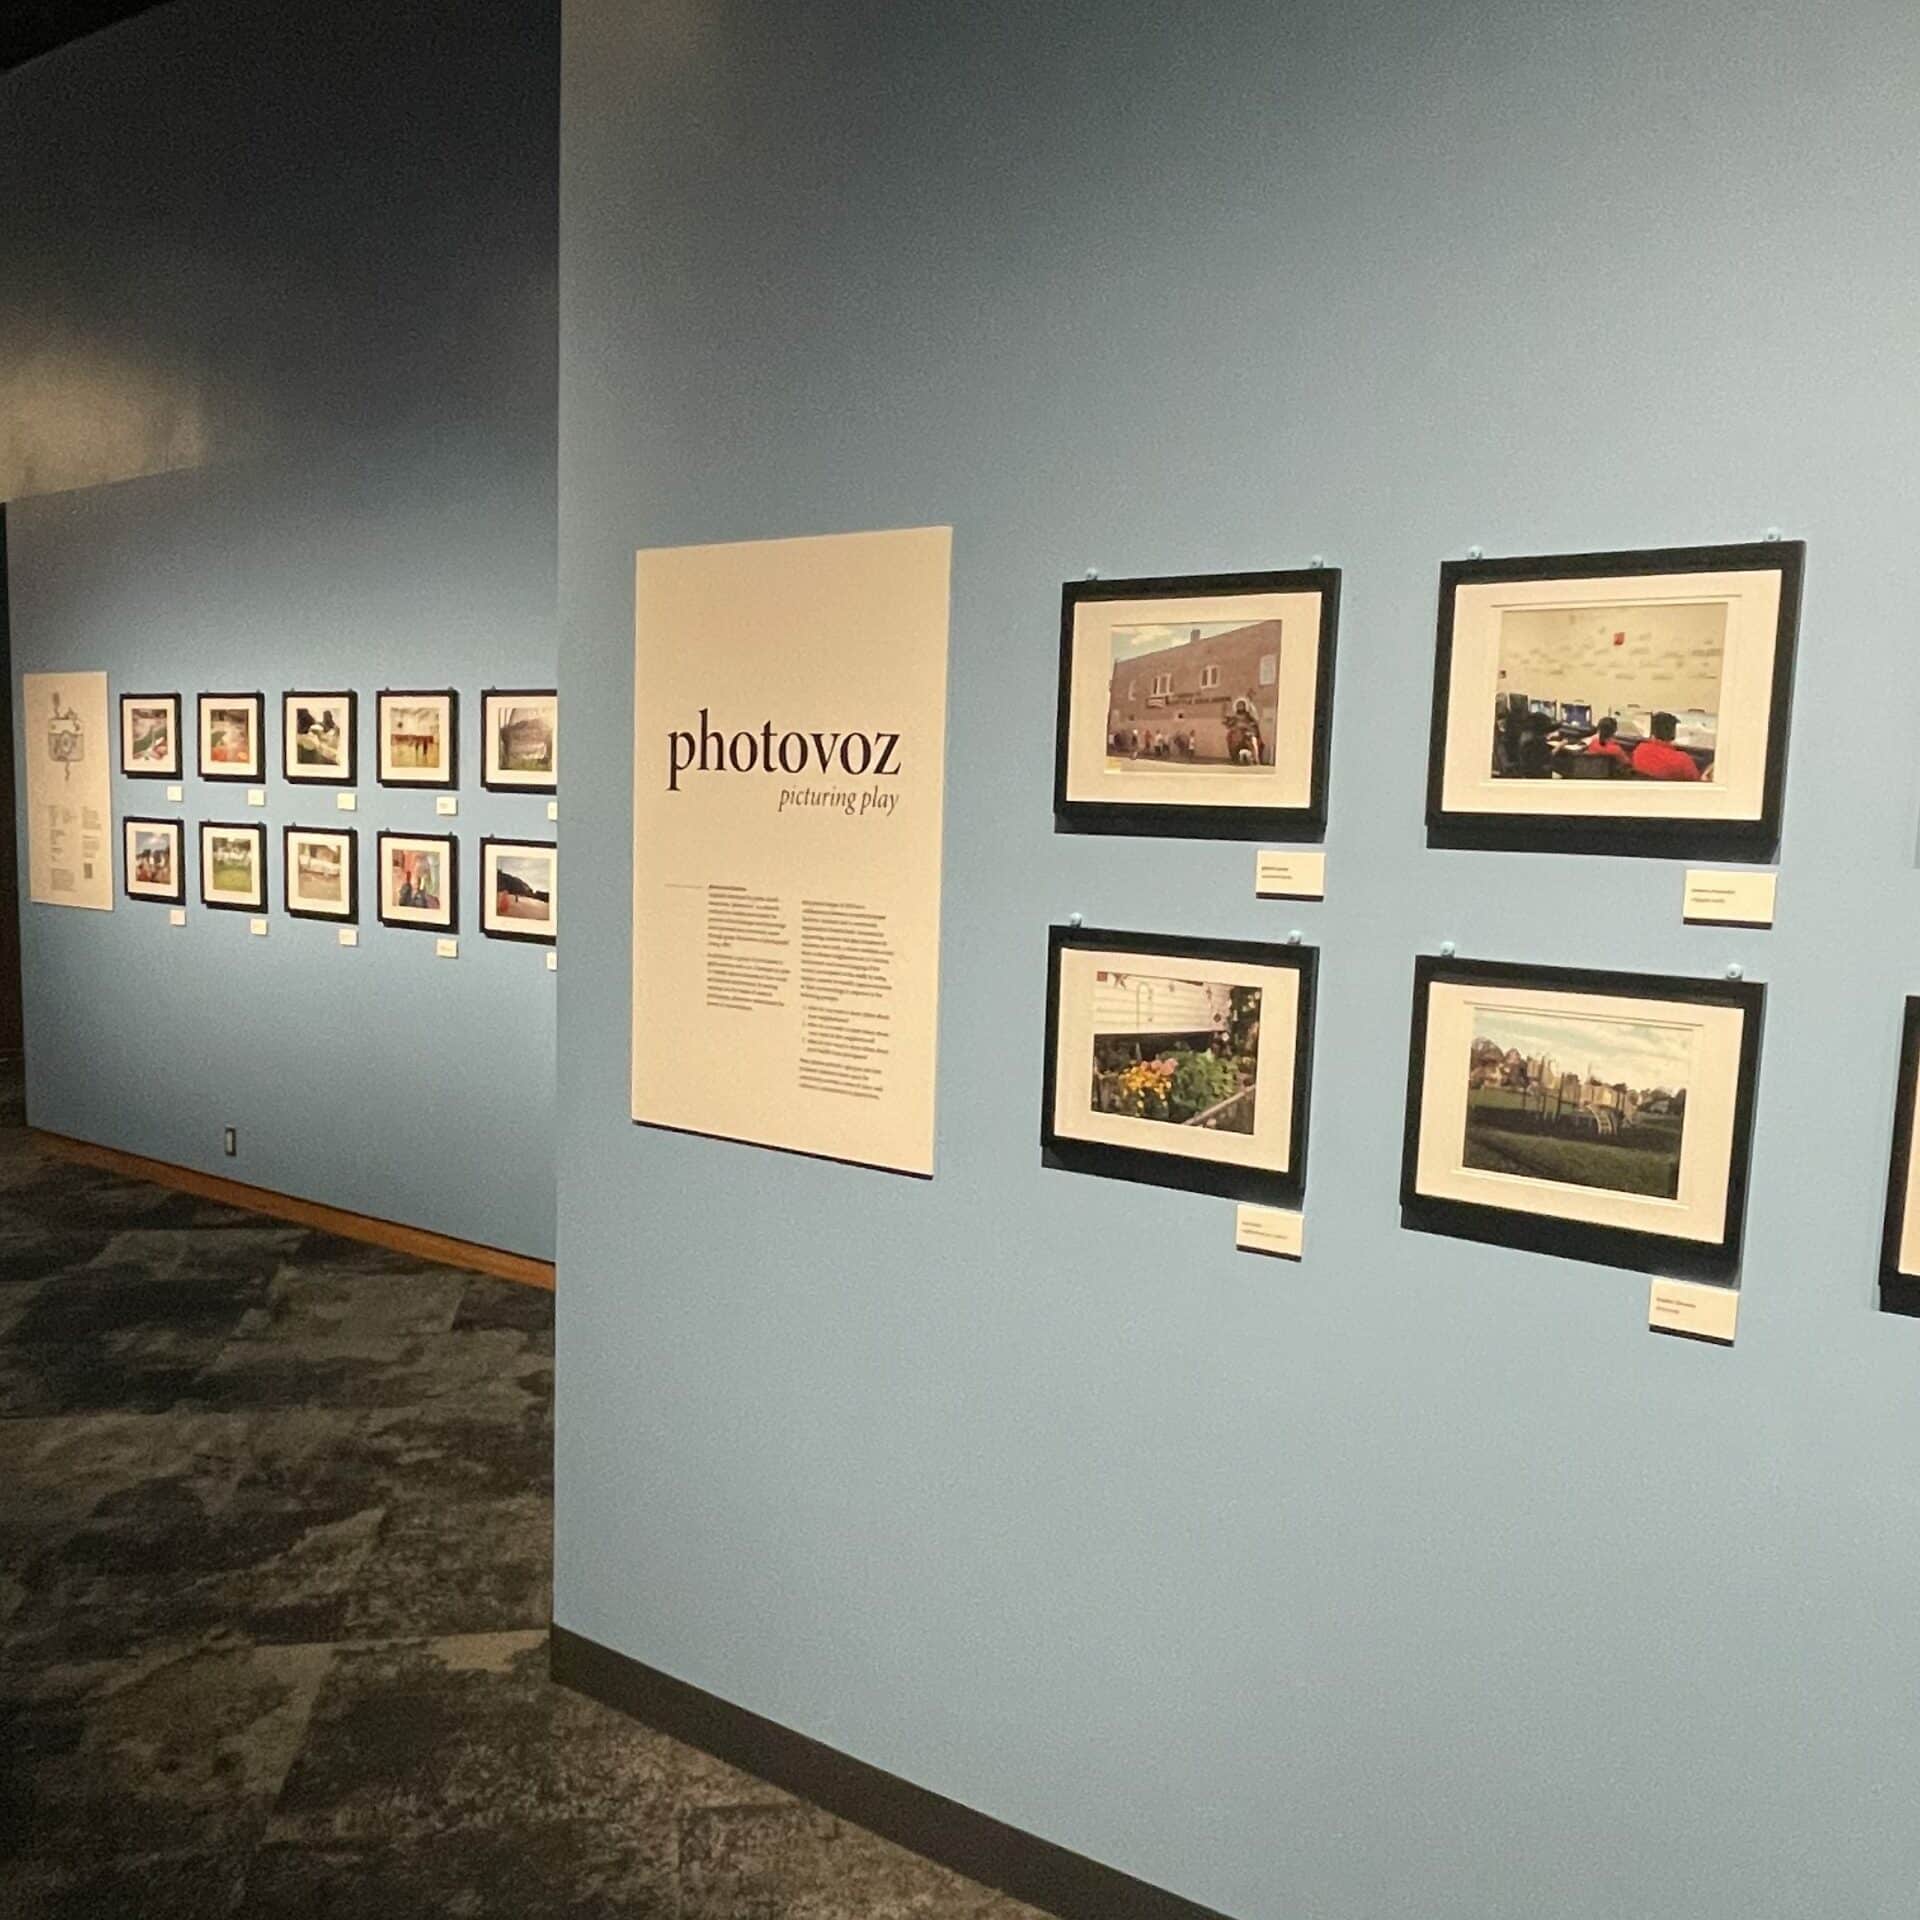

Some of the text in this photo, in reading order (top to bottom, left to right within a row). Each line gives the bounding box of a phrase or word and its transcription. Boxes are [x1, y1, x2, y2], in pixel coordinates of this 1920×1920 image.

[666, 708, 901, 791] photovoz
[778, 785, 900, 816] picturing play
